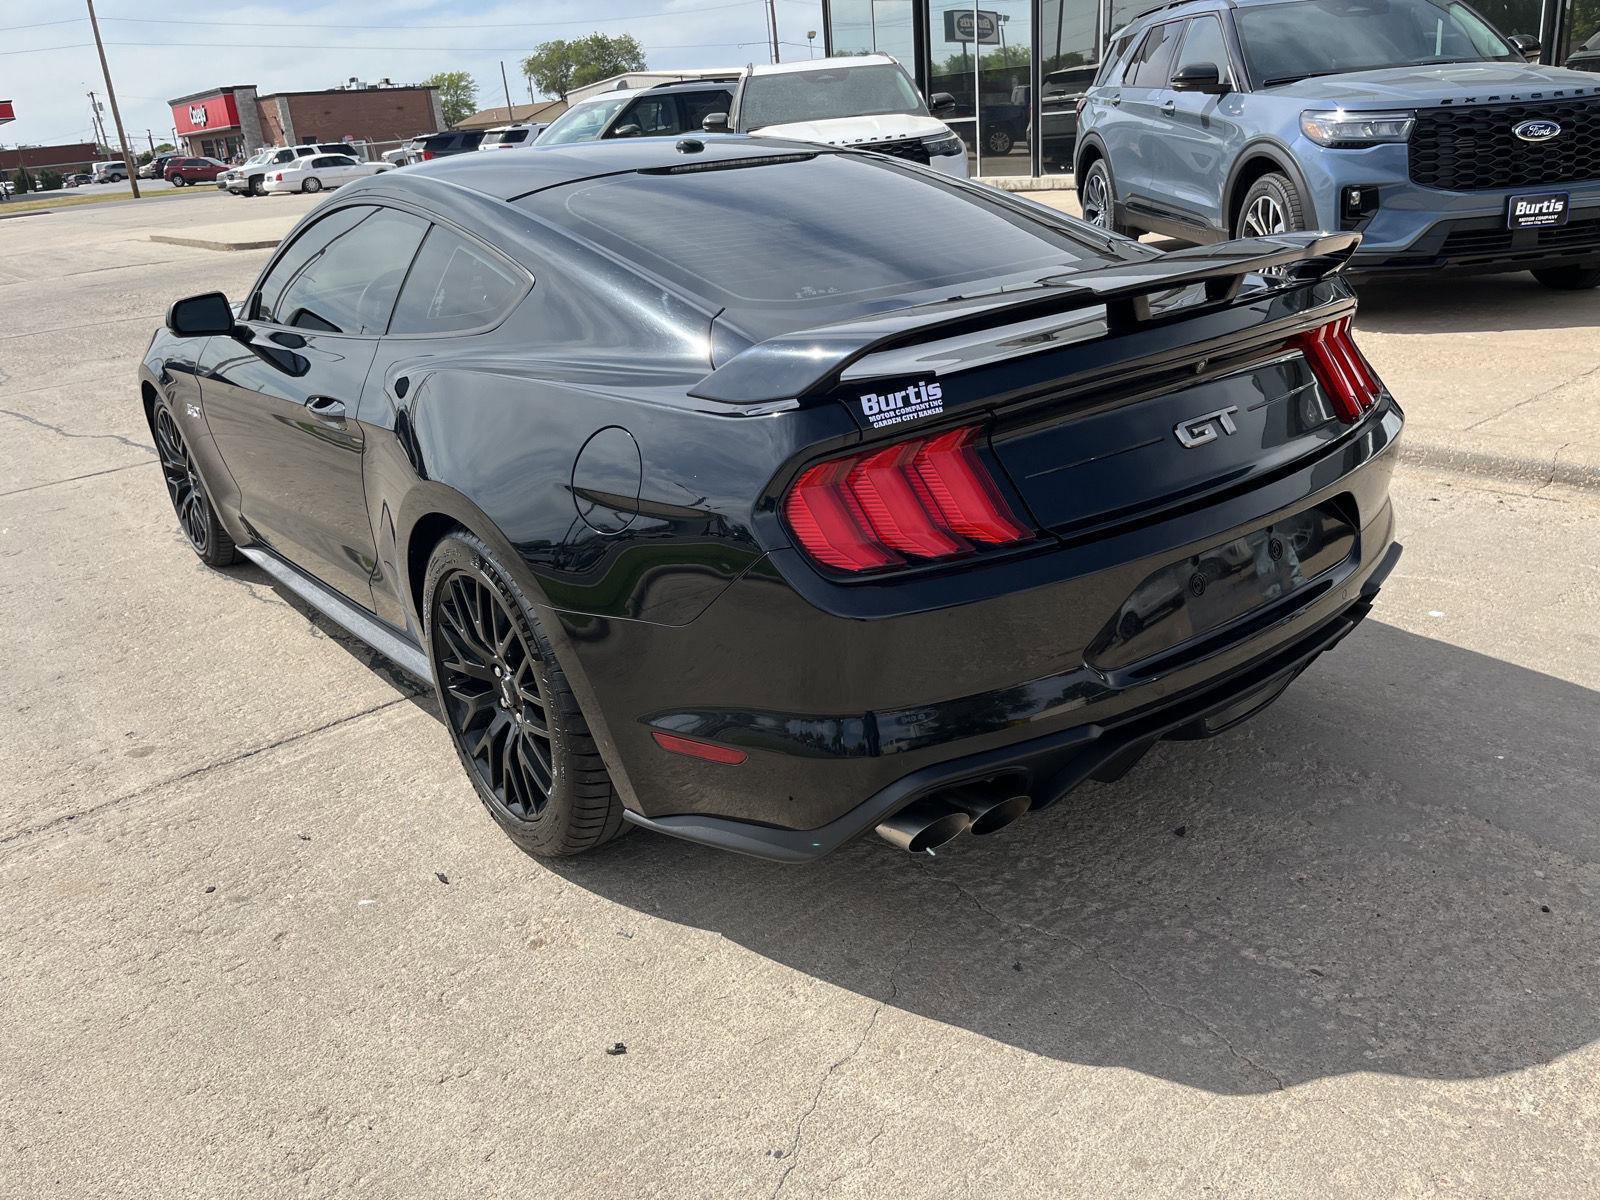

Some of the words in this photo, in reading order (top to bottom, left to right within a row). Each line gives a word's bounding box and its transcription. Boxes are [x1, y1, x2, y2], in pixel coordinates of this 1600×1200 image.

[1515, 199, 1564, 216] Burtis
[860, 381, 943, 416] Burtis
[868, 410, 896, 423] MOTOR
[895, 402, 930, 416] COMPANY
[929, 399, 944, 408] INC
[873, 416, 902, 429] GARDEN
[901, 412, 919, 423] CITY
[918, 406, 944, 418] KANSAS
[1173, 404, 1239, 449] GT
